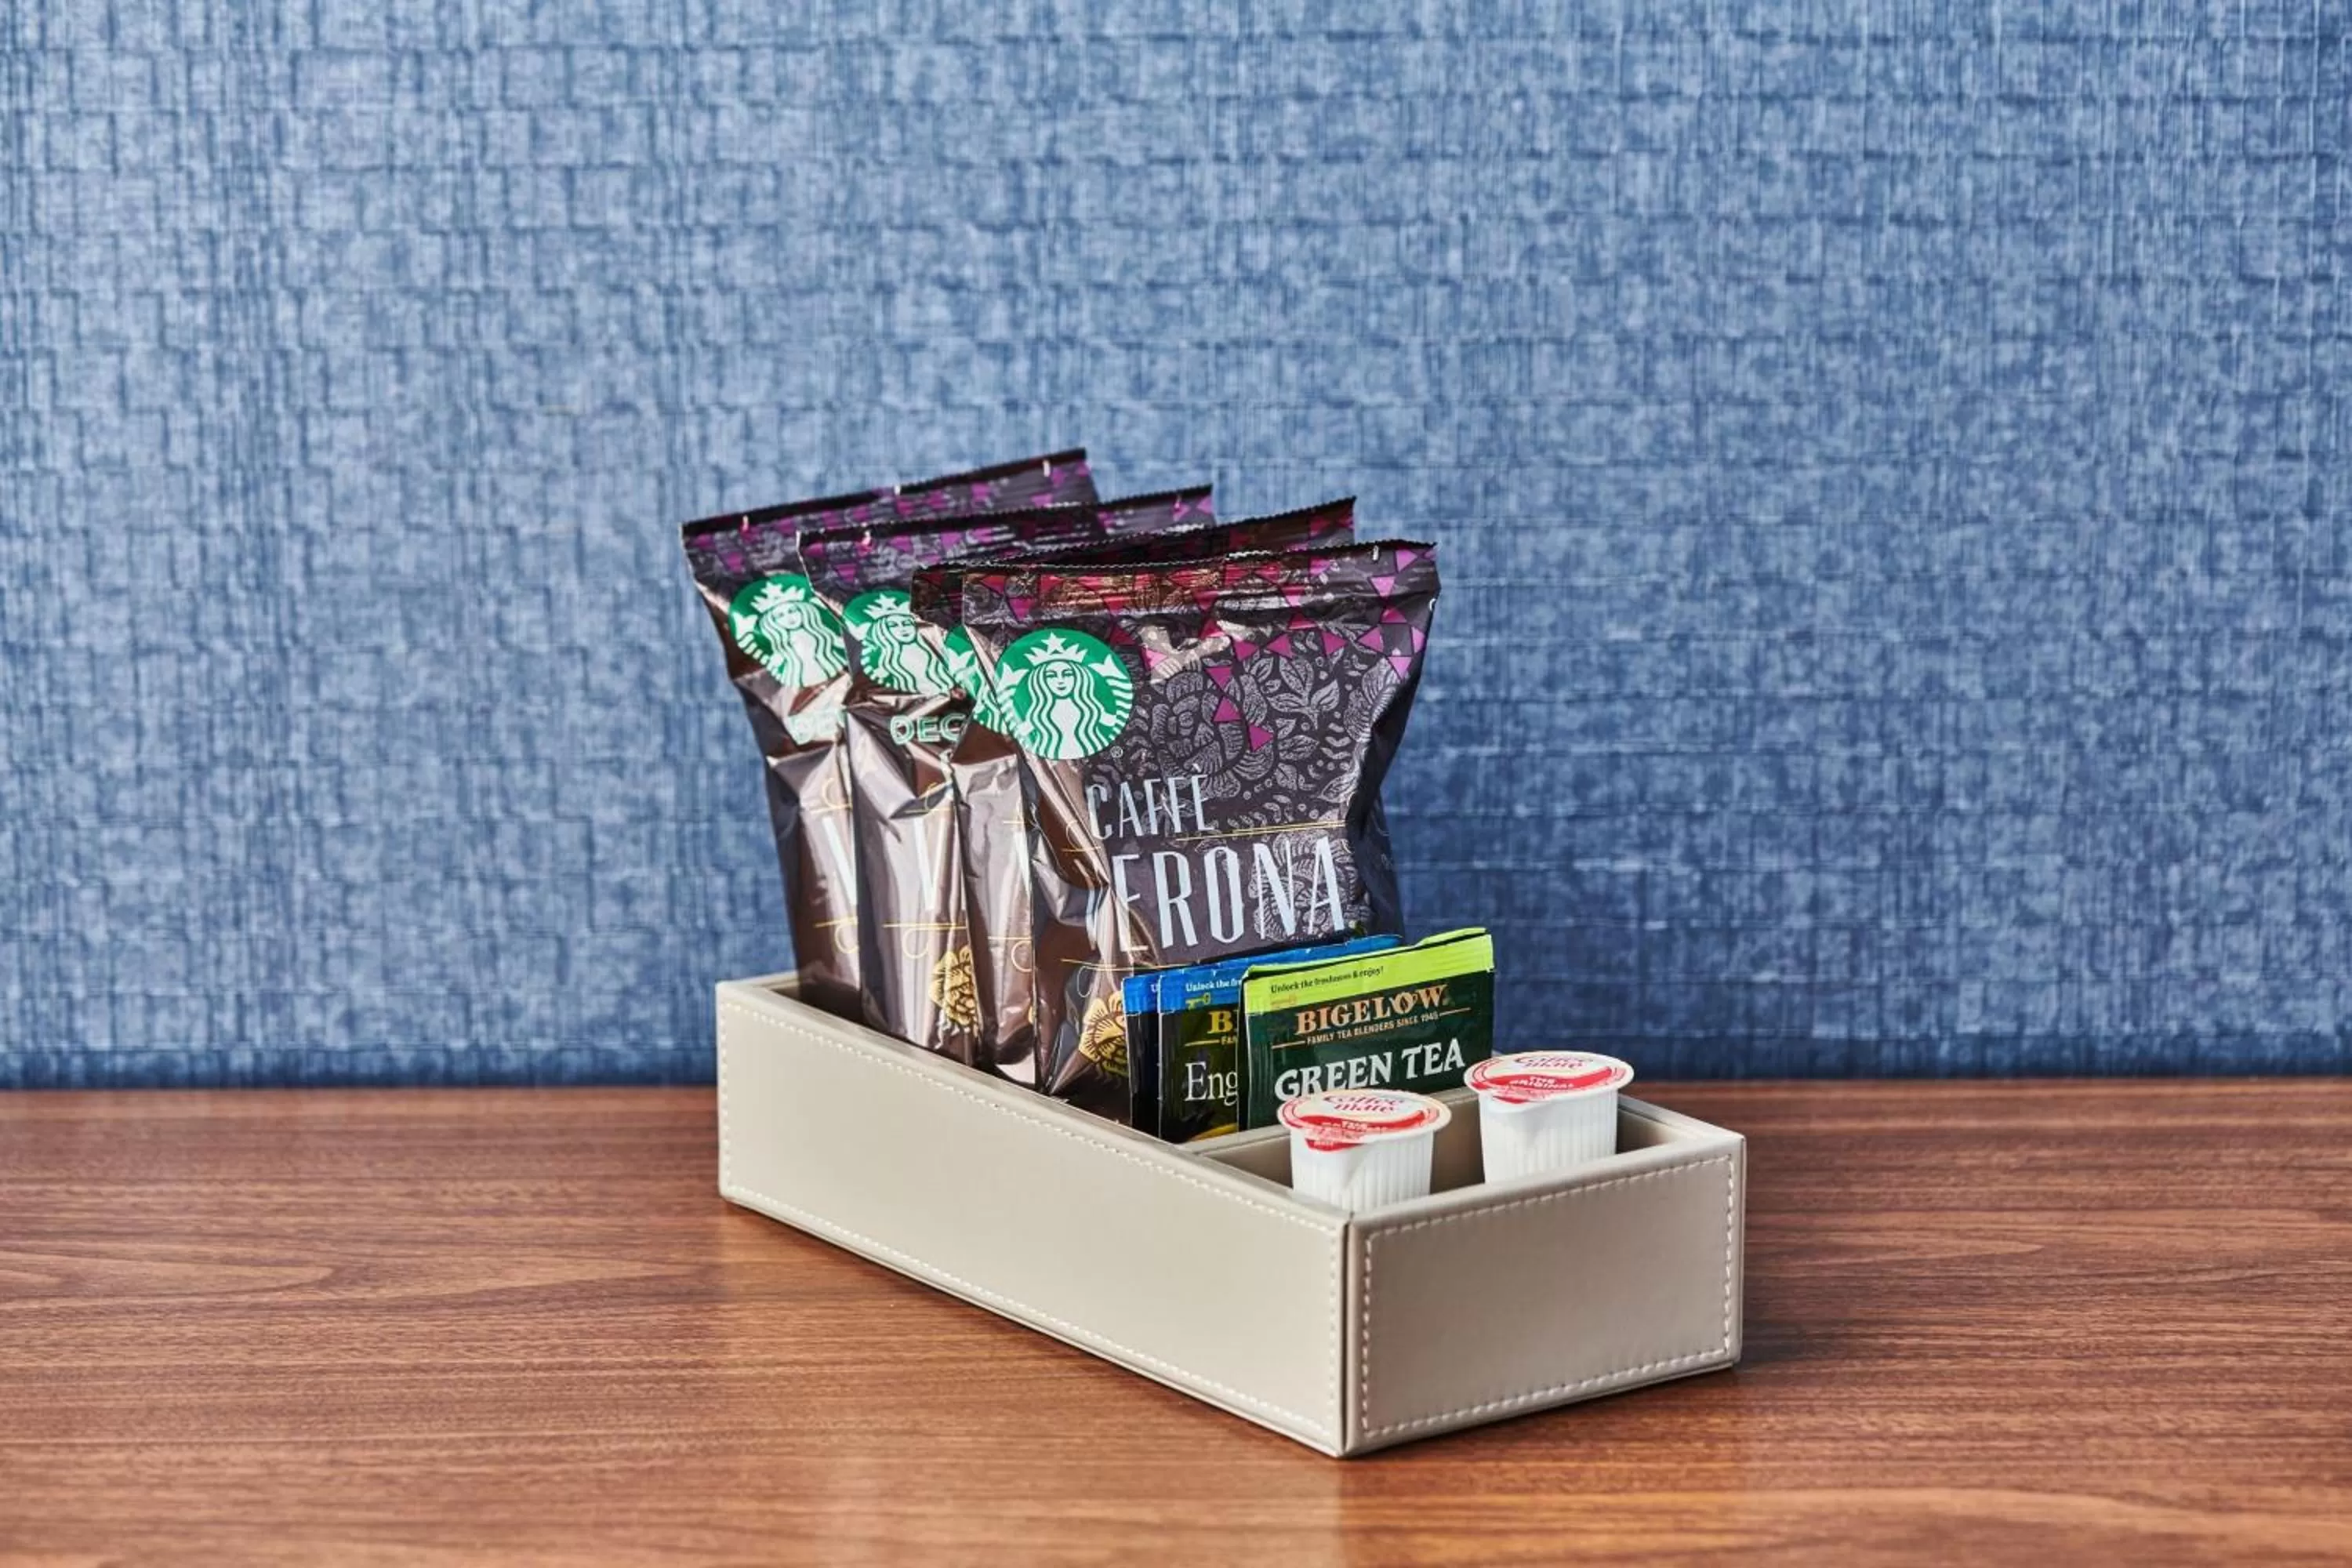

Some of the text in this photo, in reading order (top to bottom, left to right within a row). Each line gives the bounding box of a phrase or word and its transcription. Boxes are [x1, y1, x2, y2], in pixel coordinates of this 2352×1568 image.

[1185, 981, 1214, 993] Unlock
[1216, 978, 1230, 989] the
[1270, 982, 1299, 994] Unlock
[1301, 978, 1313, 989] the
[1359, 965, 1384, 978] enjoy!
[1295, 984, 1448, 1036] BIGELOW
[1306, 1033, 1334, 1045] FAMILY
[1338, 1029, 1352, 1039] TEA
[1353, 1021, 1394, 1036] BLENDERS
[1396, 1017, 1418, 1028] SINCE
[1274, 1037, 1465, 1102] GREEN TEA
